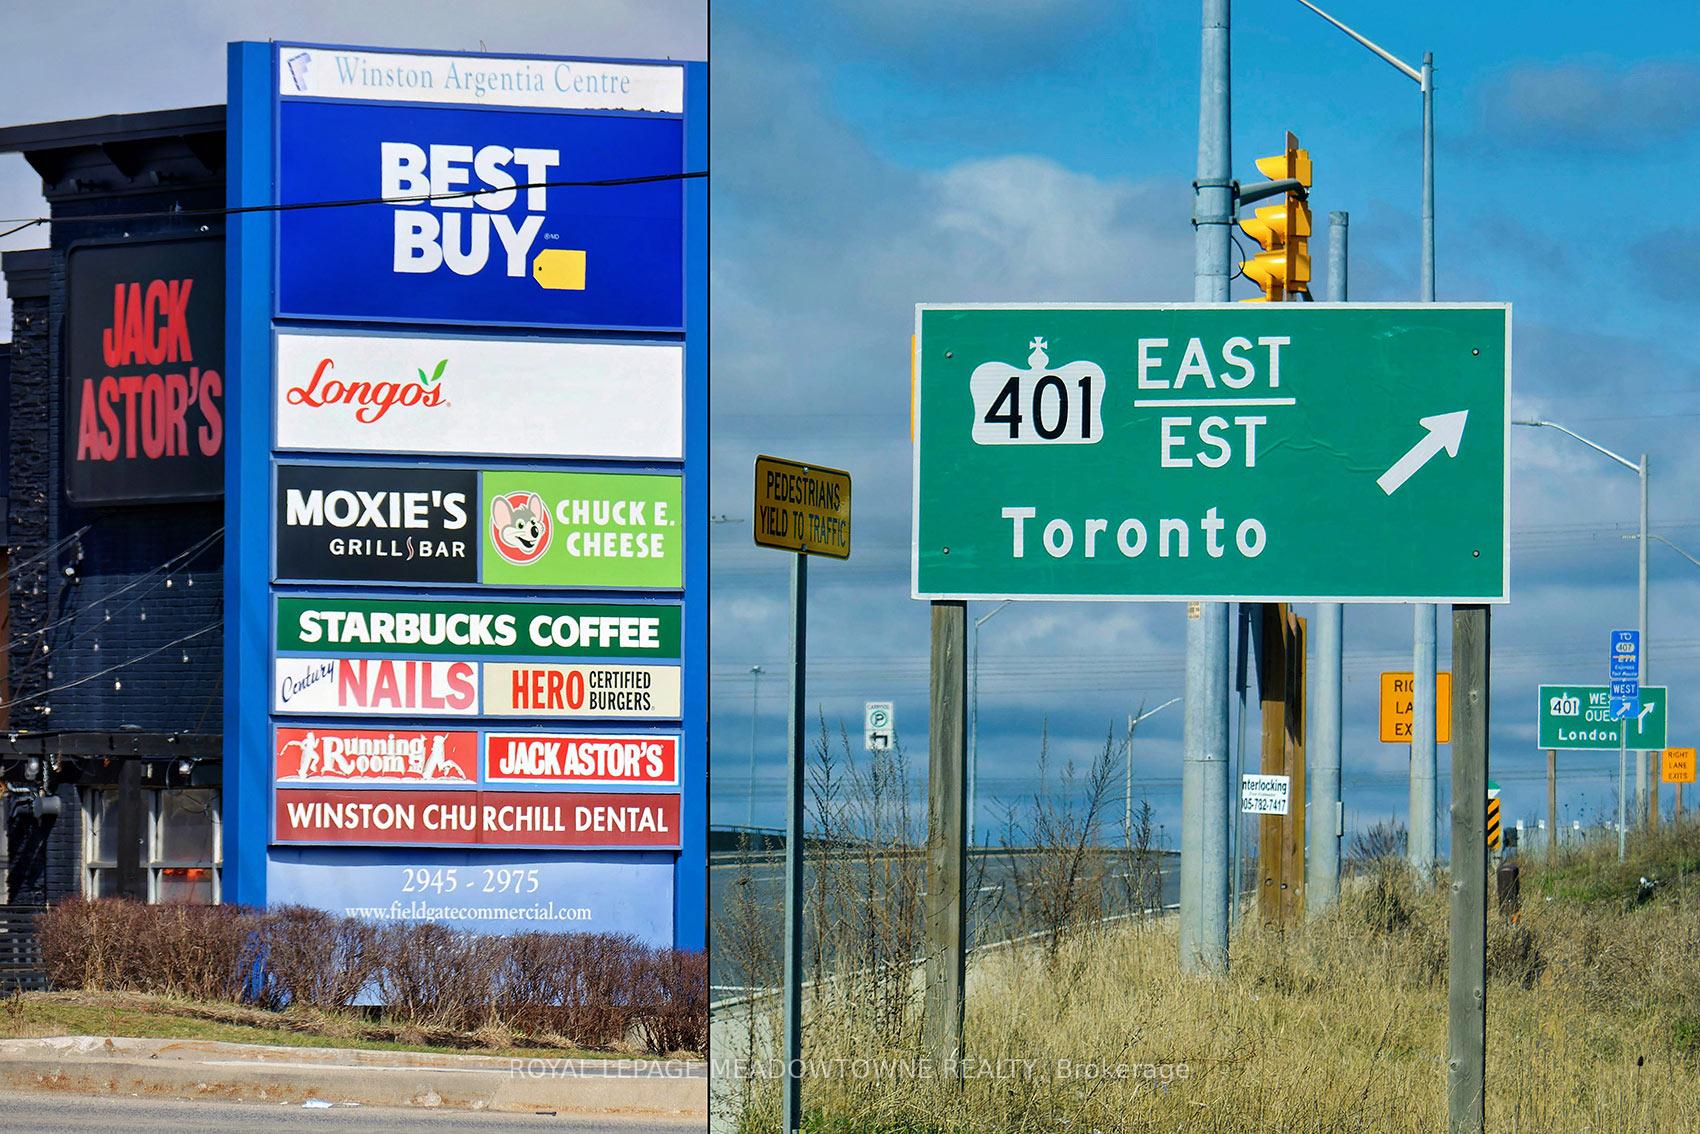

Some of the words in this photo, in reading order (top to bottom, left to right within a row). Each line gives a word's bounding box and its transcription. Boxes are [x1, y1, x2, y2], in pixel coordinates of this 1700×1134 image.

[335, 56, 433, 89] Winston
[443, 62, 544, 97] Argentia
[554, 64, 631, 94] Centre
[380, 141, 559, 211] BEST
[393, 210, 545, 277] BUY
[103, 279, 194, 367] JACK
[1137, 336, 1291, 390] EAST
[77, 366, 223, 461] ASTOR'S
[984, 375, 1092, 440] 401
[1161, 416, 1267, 469] EST
[286, 489, 467, 529] MOXIE'S
[766, 470, 840, 511] PEDESTRIANS
[556, 499, 647, 526] CHUCK
[655, 501, 675, 526] E.
[760, 505, 788, 537] YIELD
[792, 511, 804, 541] TO
[809, 514, 846, 548] TRAFFIC
[329, 538, 402, 557] GRILL
[420, 541, 465, 558] BAR
[566, 532, 664, 558] CHEESE
[1001, 506, 1267, 558] Toronto
[299, 610, 517, 647] STARBUCKS
[528, 614, 659, 649] COFFEE
[281, 661, 334, 703] Century
[338, 659, 475, 710] NAILS
[512, 670, 584, 710] HERO
[589, 671, 651, 689] CERTIFIED
[1613, 685, 1635, 694] WEST
[589, 692, 651, 711] BURGERS
[1553, 700, 1576, 714] 401
[321, 733, 427, 765] Running
[1558, 728, 1617, 740] London
[499, 741, 561, 775] JACK
[563, 741, 664, 778] ASTOR'S
[1242, 779, 1287, 795] nterlocking
[1242, 798, 1286, 811] 05-782-7417
[287, 802, 415, 830] WINSTON
[423, 804, 566, 832] CHURCHILL
[575, 806, 668, 833] DENTAL
[402, 868, 458, 894] 2945
[482, 868, 540, 893] 2975
[345, 901, 592, 922] www.fieldgatecommercial.com
